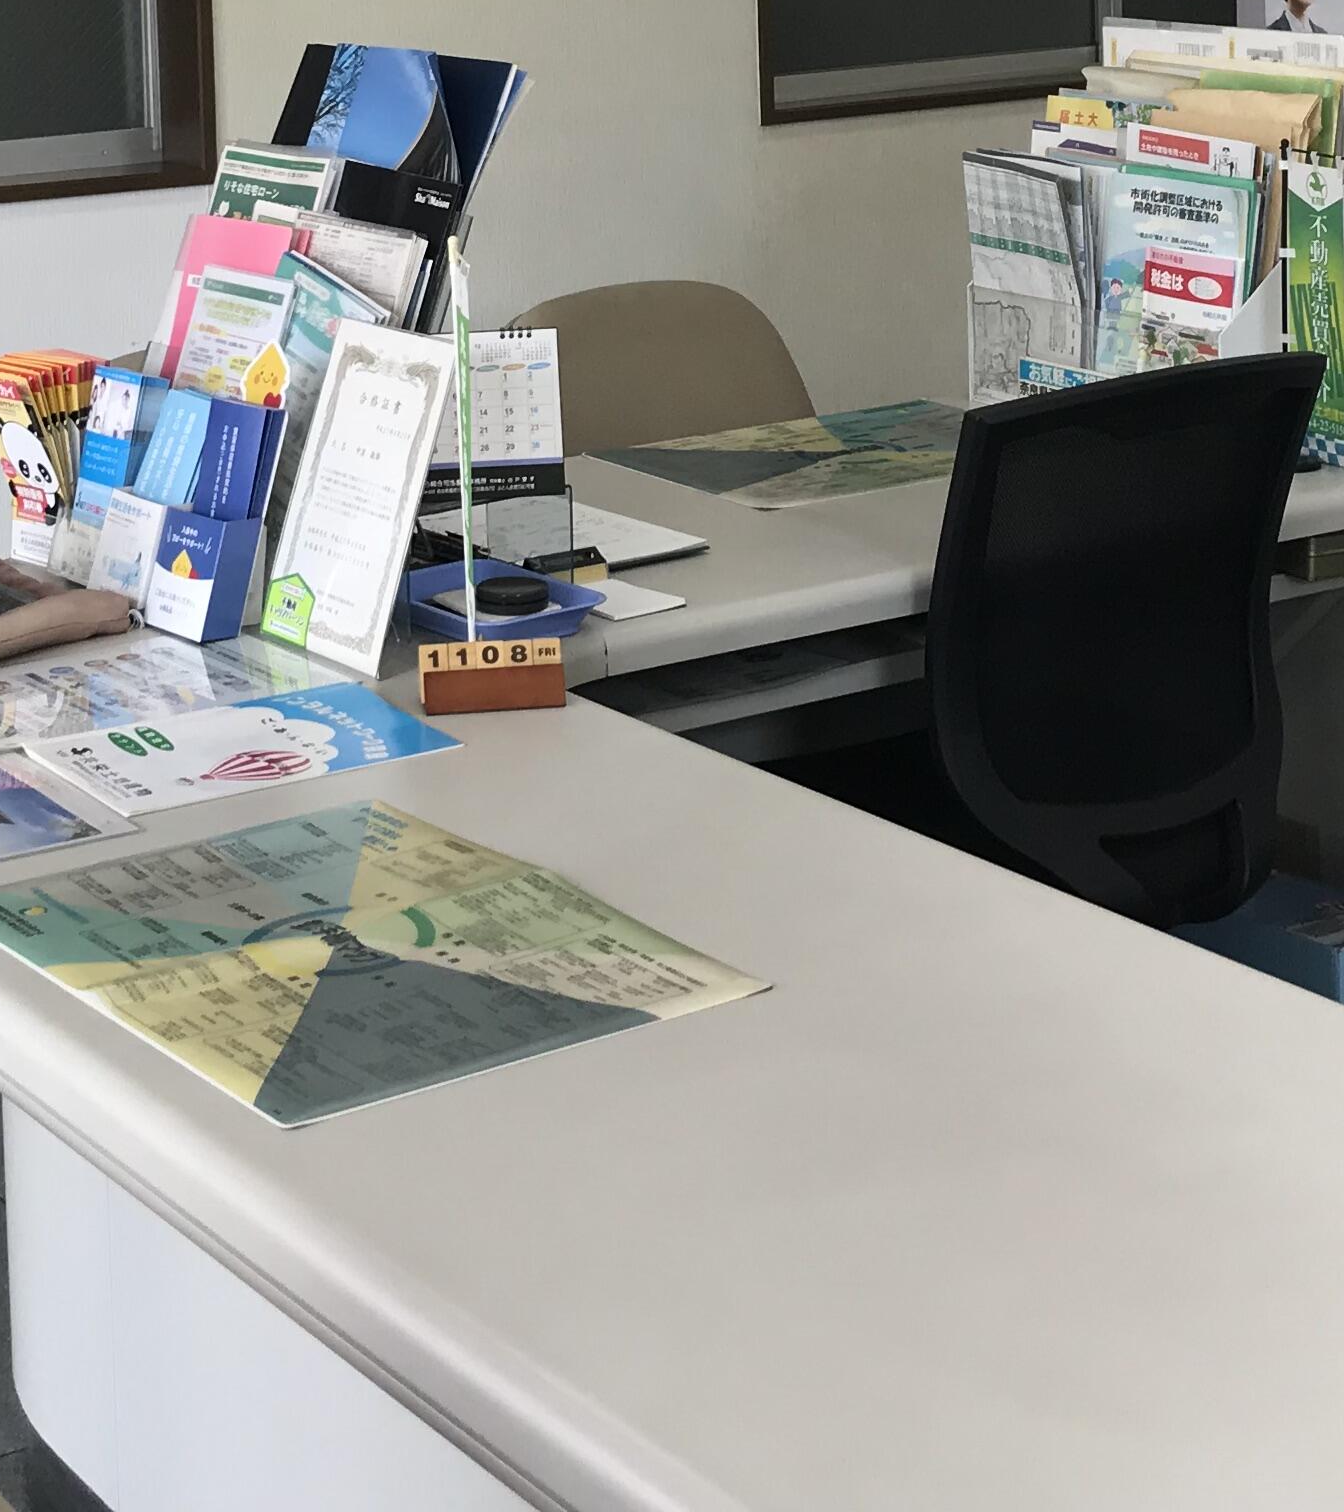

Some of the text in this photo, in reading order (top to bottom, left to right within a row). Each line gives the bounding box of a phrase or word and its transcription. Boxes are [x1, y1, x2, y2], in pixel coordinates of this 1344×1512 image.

[223, 180, 281, 200] りそな住宅ローン
[1130, 188, 1224, 212] 市街化調整区域における
[1132, 202, 1220, 225] 開発許可の審査基準の
[1150, 268, 1185, 292] 税金は
[538, 648, 556, 658] FRI
